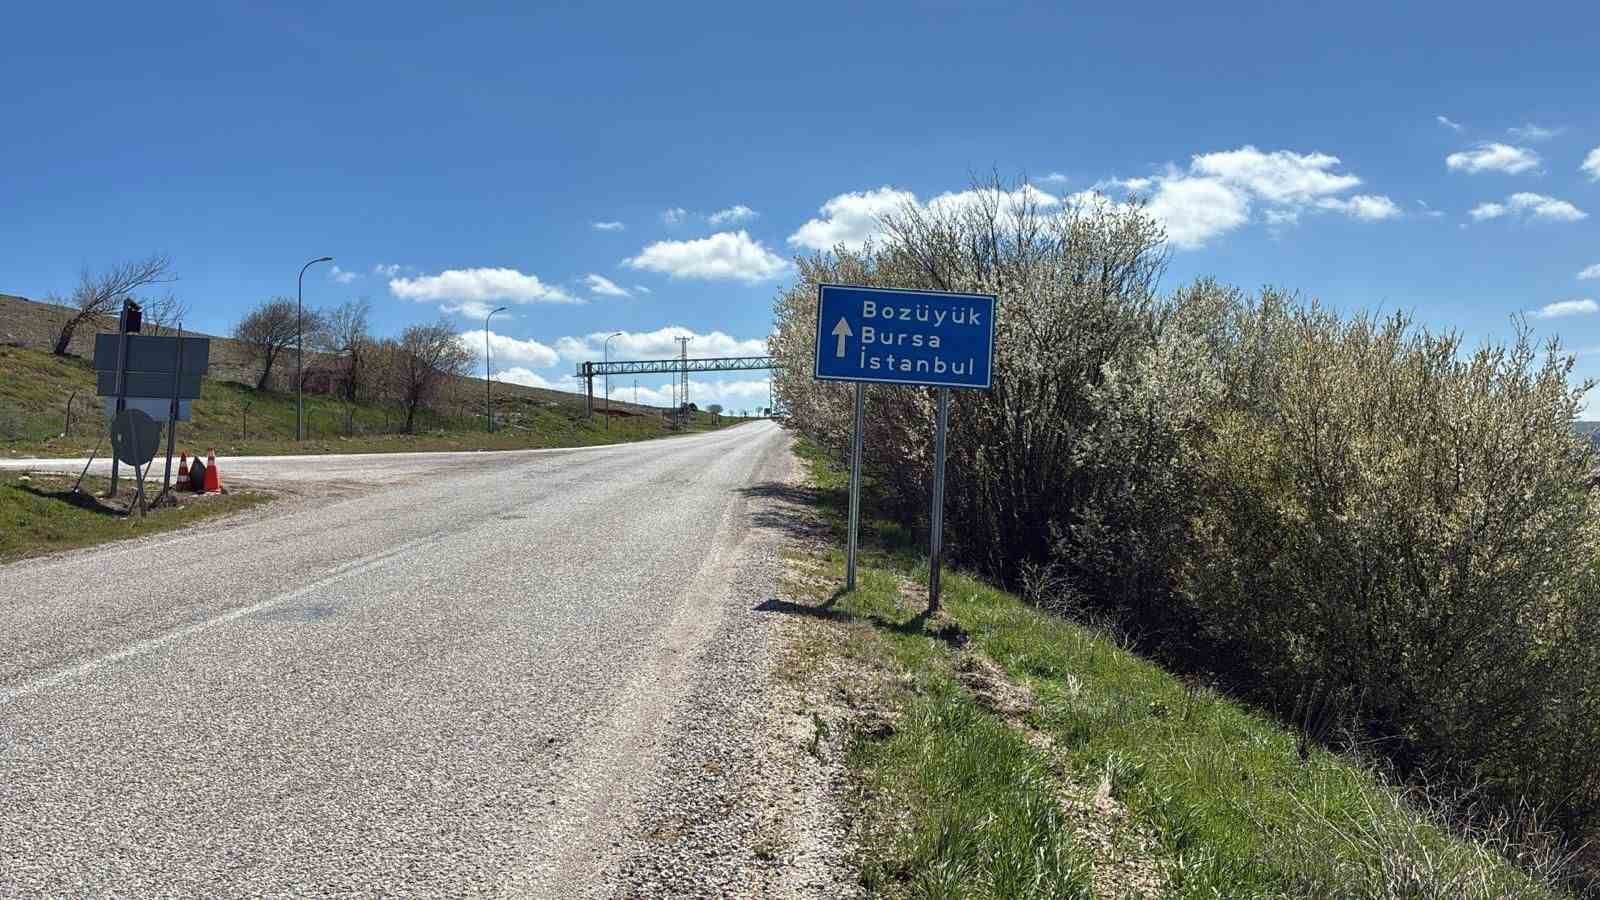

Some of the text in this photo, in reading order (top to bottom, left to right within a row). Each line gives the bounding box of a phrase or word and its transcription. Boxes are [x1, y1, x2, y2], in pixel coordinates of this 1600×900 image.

[862, 300, 982, 328] Bozüyük
[861, 326, 941, 348] Bursa
[860, 346, 974, 375] İstanbul
